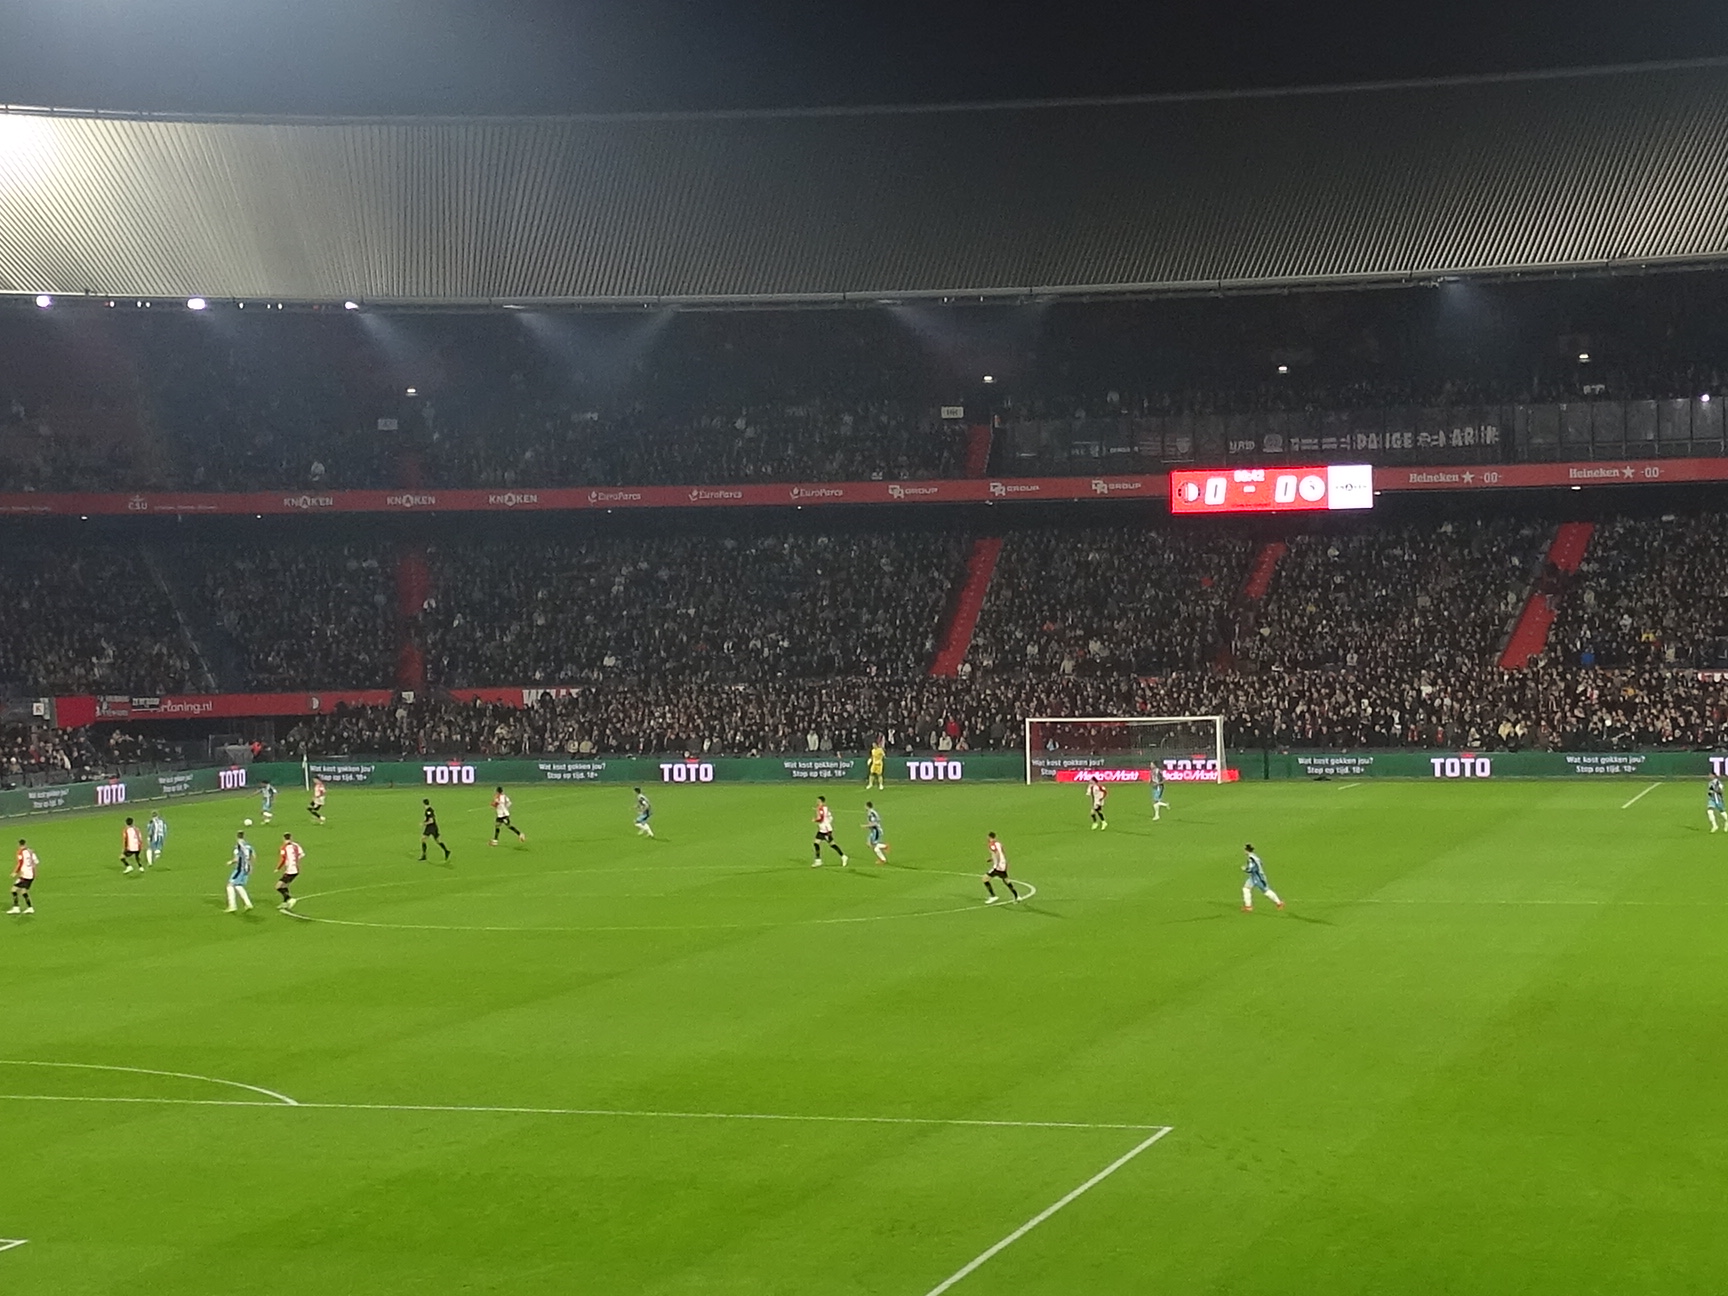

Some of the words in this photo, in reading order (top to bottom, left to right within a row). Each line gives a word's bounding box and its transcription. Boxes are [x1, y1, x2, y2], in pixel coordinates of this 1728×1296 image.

[1409, 473, 1459, 483] Heineken
[1569, 468, 1620, 479] Heineken
[283, 495, 333, 508] KNAKEN
[386, 494, 435, 507] KNAKEN
[489, 492, 538, 506] KNAKEN
[423, 765, 475, 785] TOTO
[660, 763, 714, 783] TOTO
[906, 761, 964, 781] TOTO
[1431, 757, 1491, 778] TOTO
[219, 769, 246, 790] TOTO
[97, 784, 126, 806] TOTO
